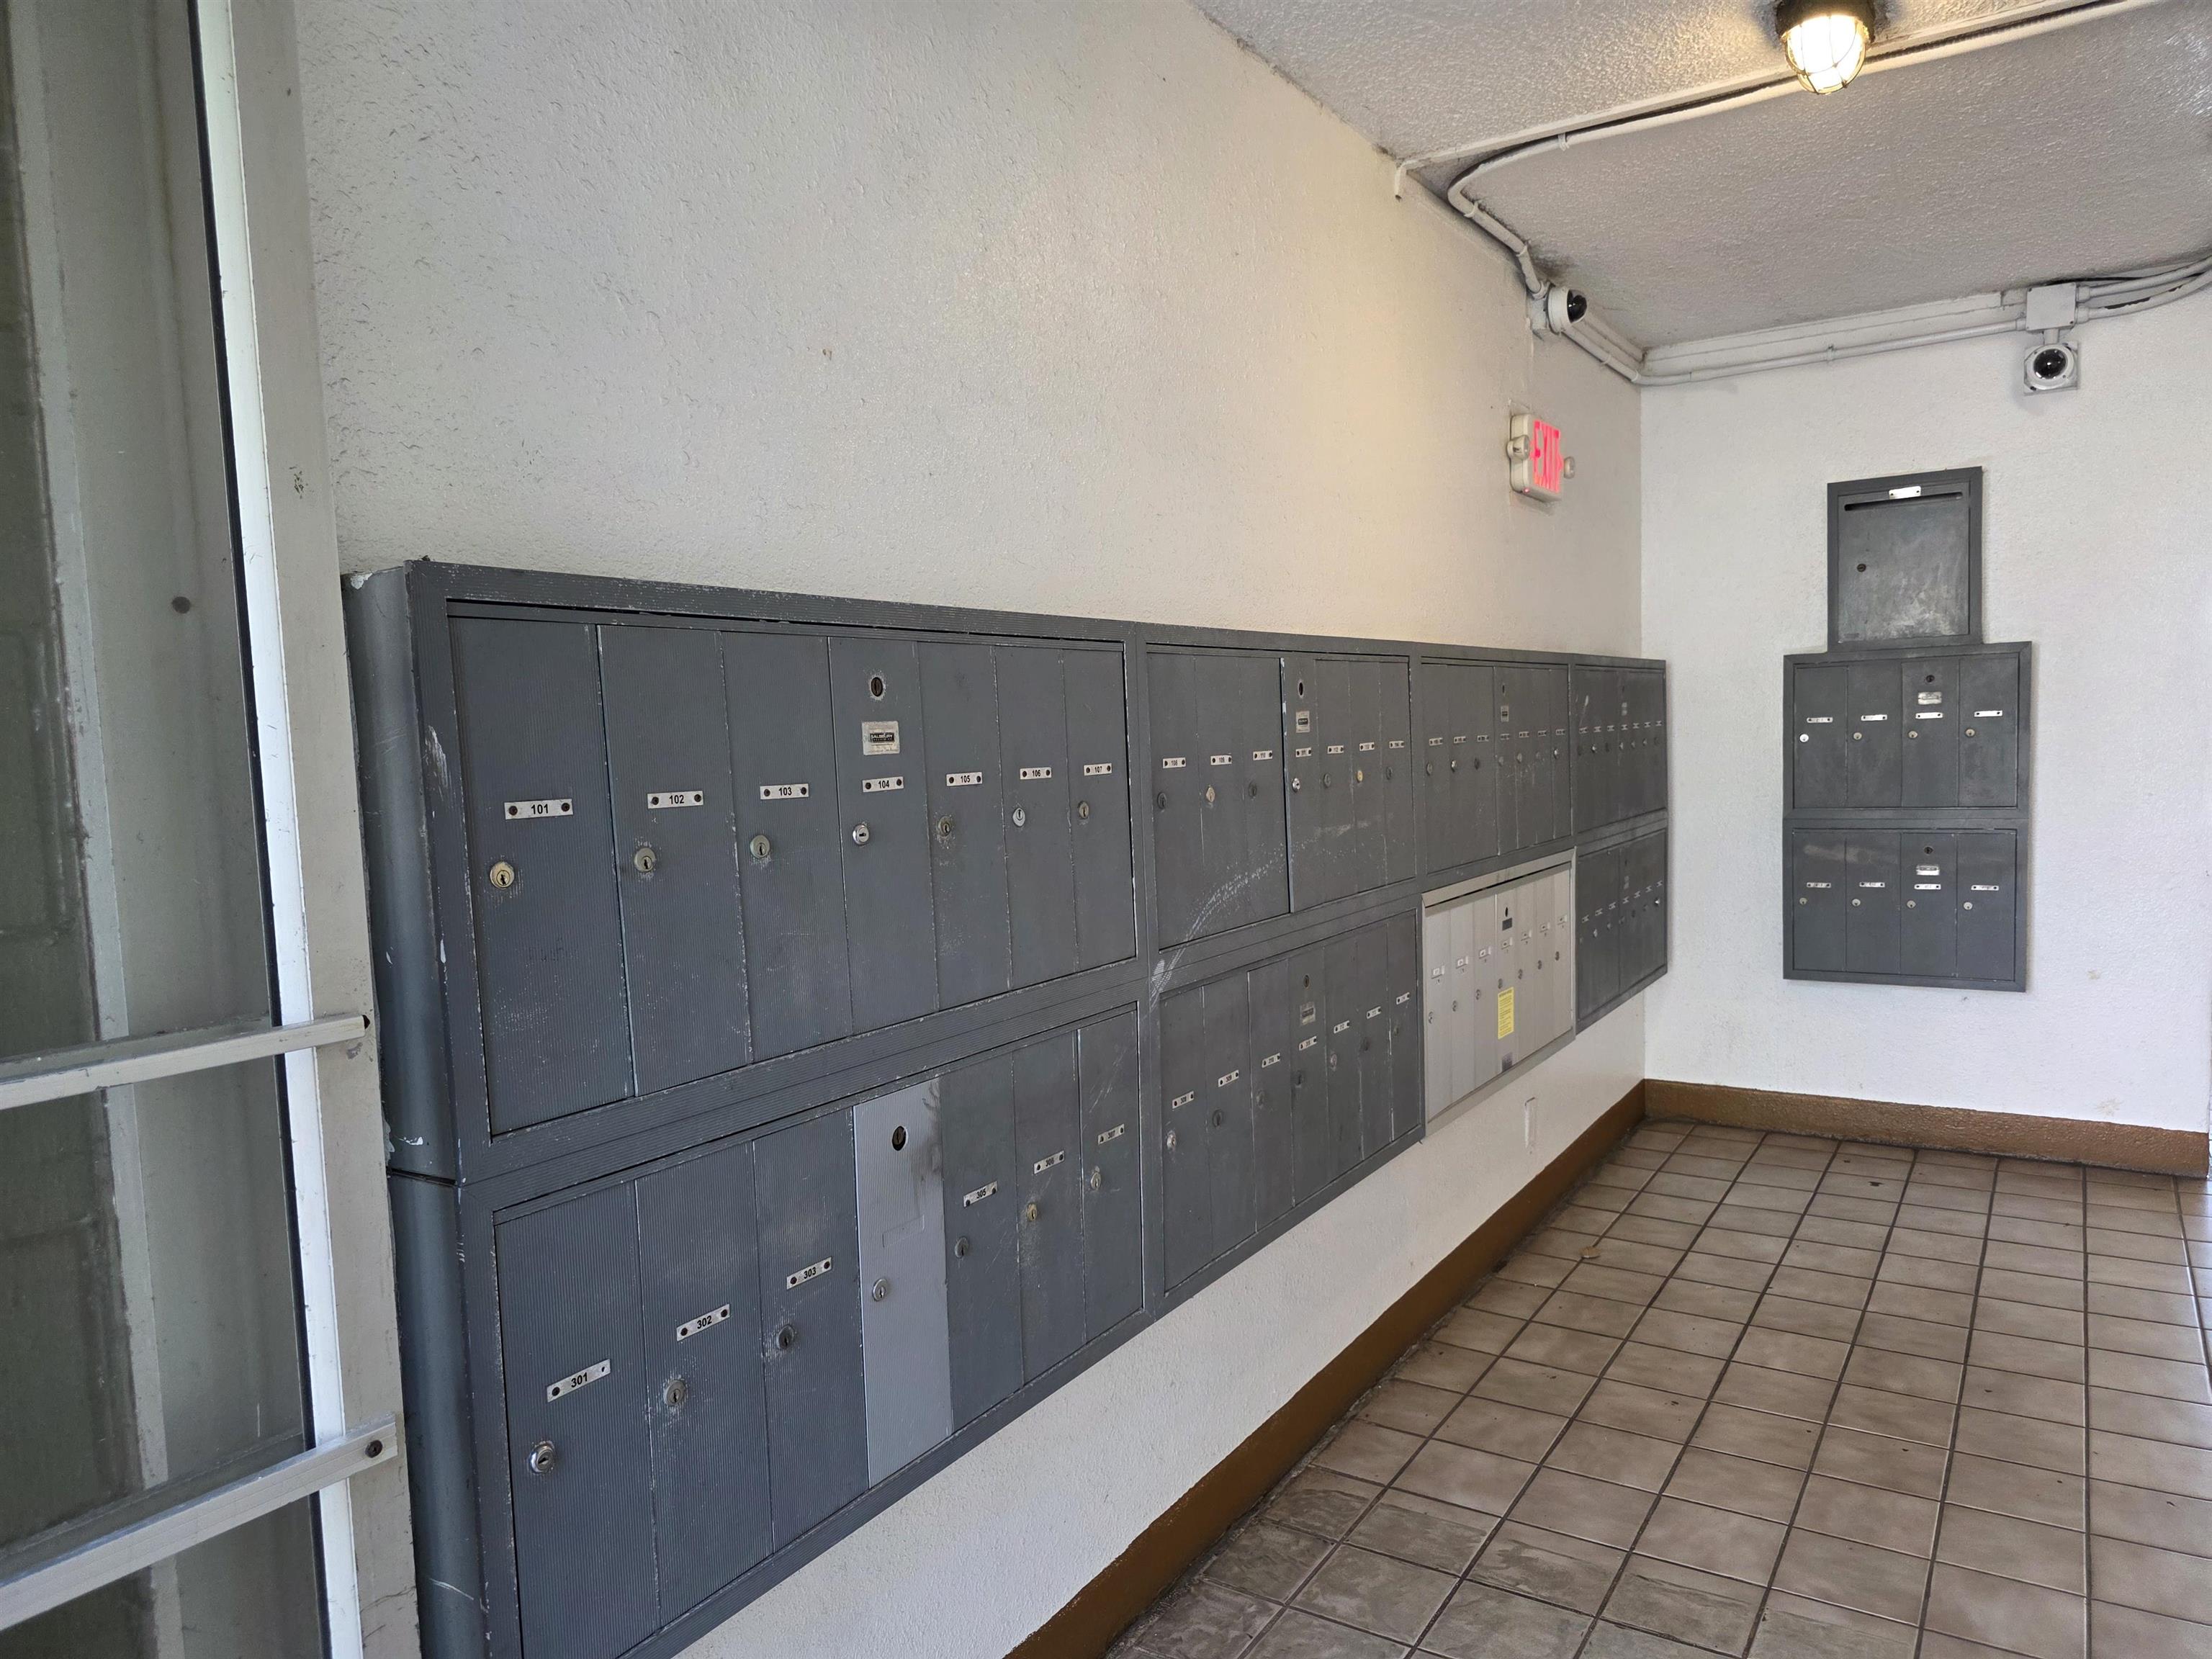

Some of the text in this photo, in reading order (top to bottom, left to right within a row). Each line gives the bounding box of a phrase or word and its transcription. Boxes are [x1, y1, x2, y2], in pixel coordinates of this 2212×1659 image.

[1532, 419, 1560, 494] EXIT
[878, 780, 890, 788] 104
[960, 775, 971, 784] 105
[778, 786, 793, 796] 103
[669, 794, 685, 804] 102
[531, 804, 549, 815] 101
[976, 1188, 986, 1199] 305
[803, 1267, 817, 1280] 303
[696, 1315, 712, 1329] 302
[570, 1372, 588, 1388] 301
